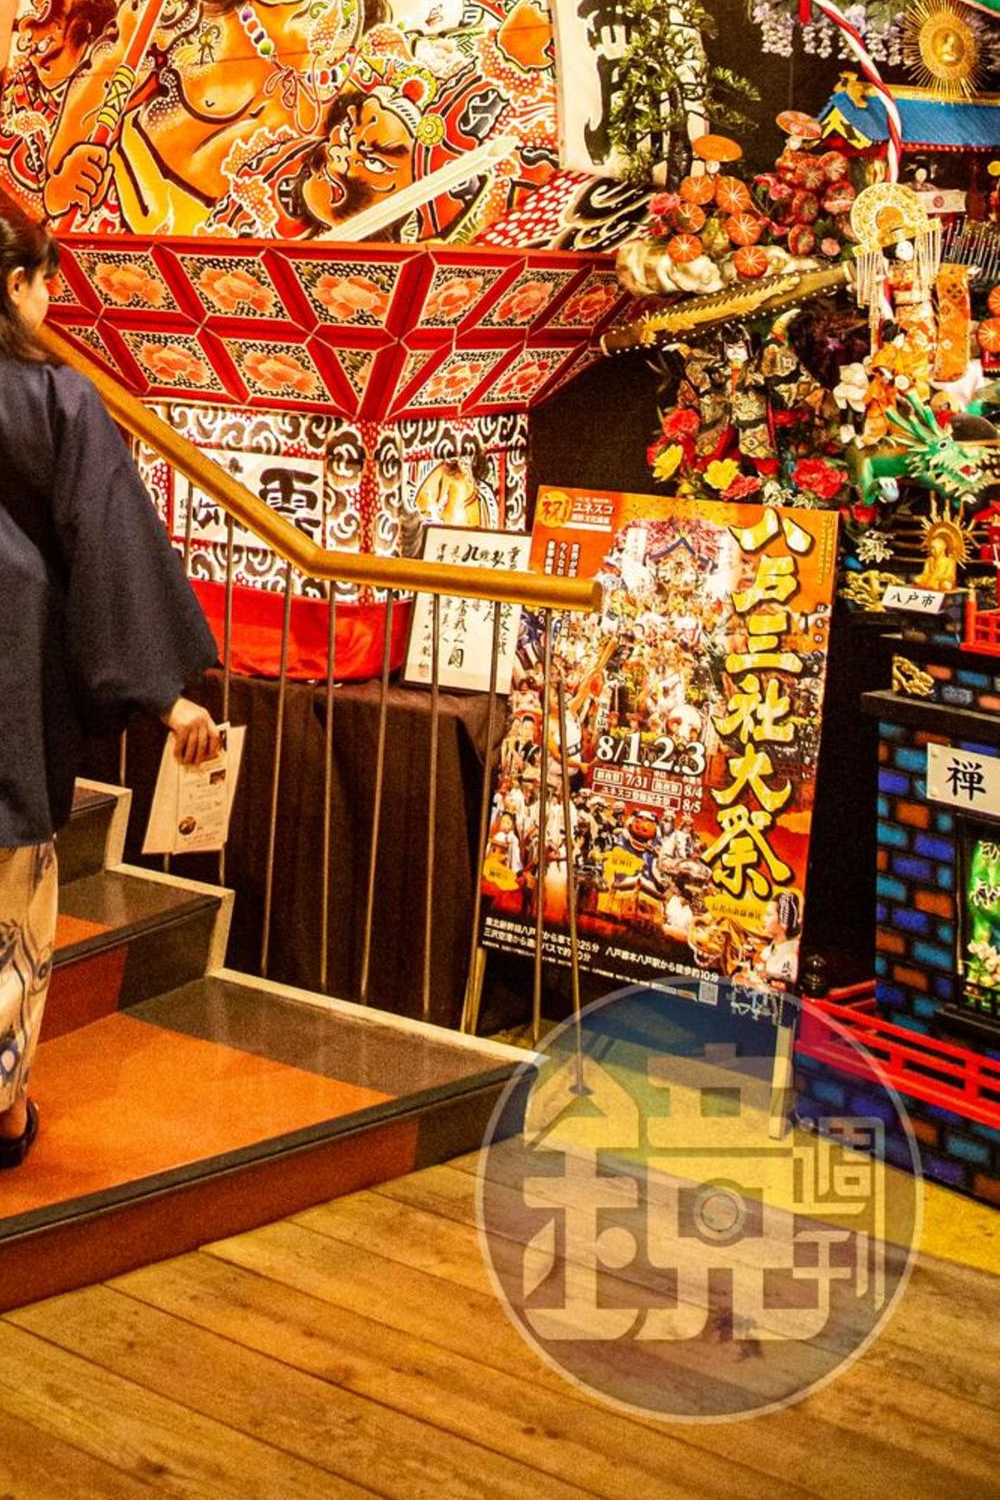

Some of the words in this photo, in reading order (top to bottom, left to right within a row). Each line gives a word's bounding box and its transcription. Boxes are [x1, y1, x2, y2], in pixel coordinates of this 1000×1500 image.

[890, 591, 936, 607] 八戸市
[625, 773, 649, 789] 7/31
[945, 757, 987, 801] 禅
[684, 785, 703, 799] 8/4
[682, 799, 702, 814] 8/5
